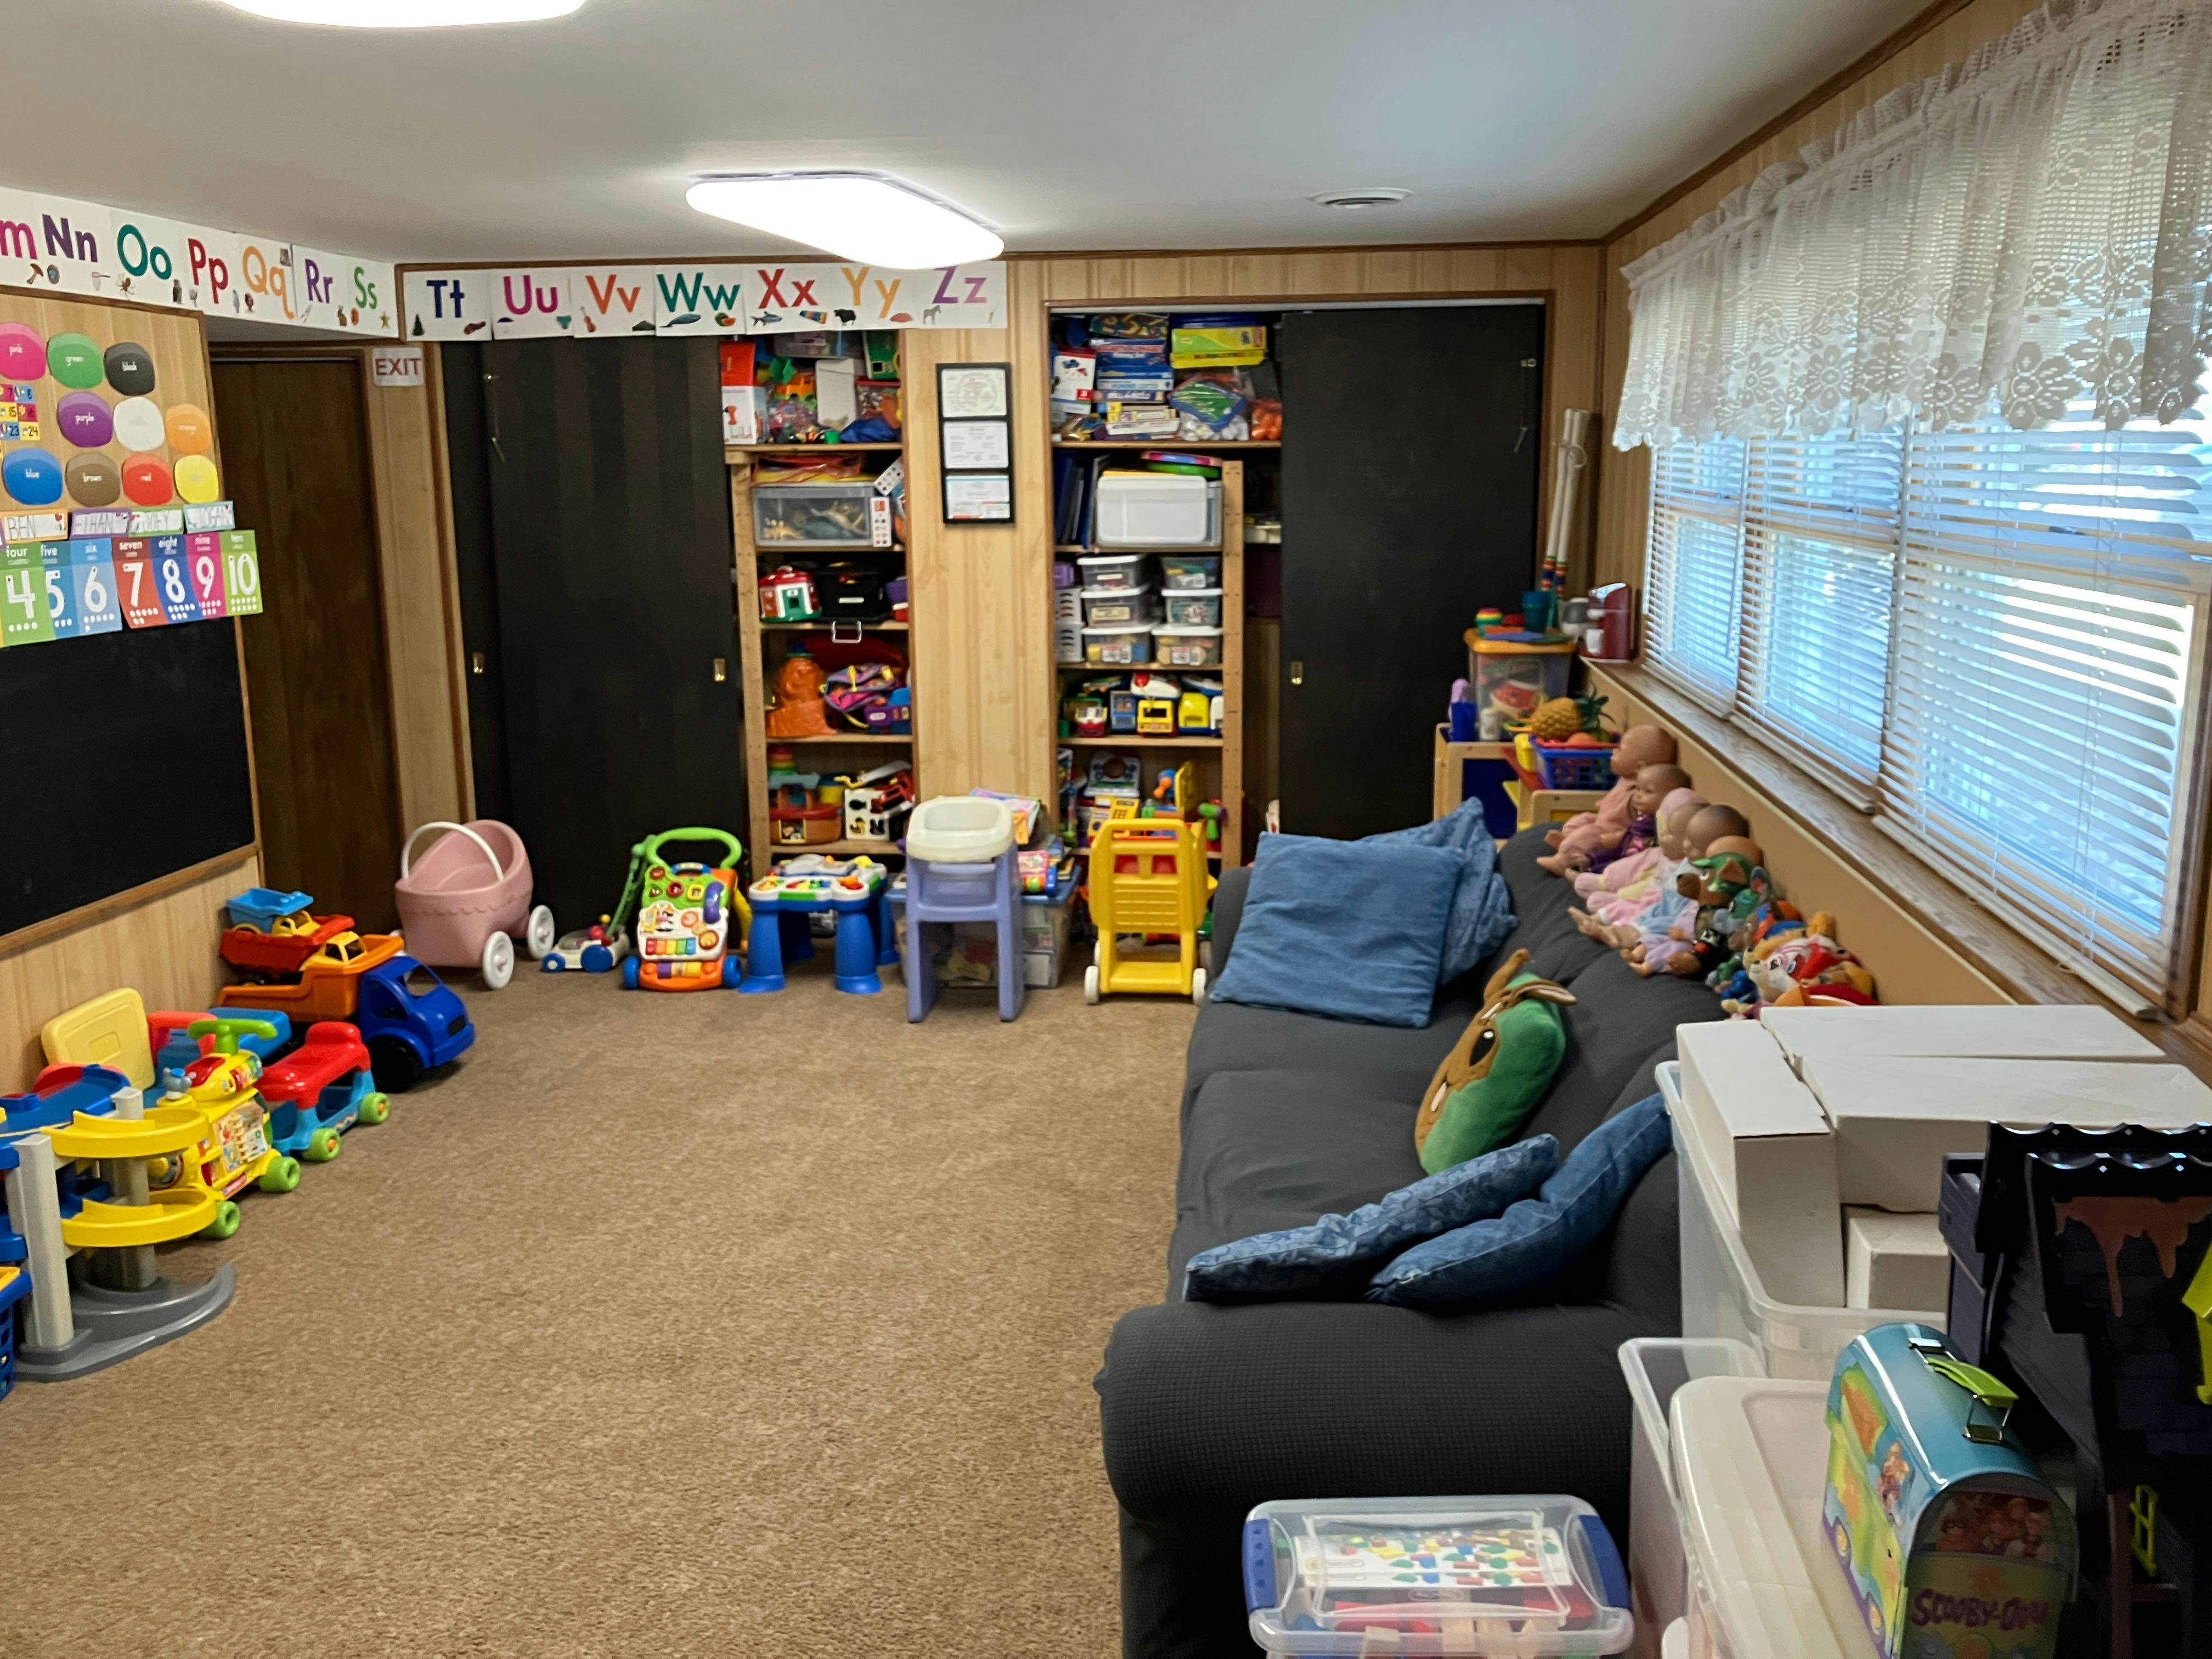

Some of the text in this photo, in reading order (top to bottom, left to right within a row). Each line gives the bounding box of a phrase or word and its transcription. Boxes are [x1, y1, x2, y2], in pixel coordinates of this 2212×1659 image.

[42, 213, 98, 263] Nn
[117, 224, 172, 280] Oo
[188, 238, 228, 304] Pp
[242, 245, 295, 320] Qq
[305, 258, 334, 304] Rr
[354, 266, 378, 310] Ss
[427, 266, 988, 319] Tt Uu Vv Ww Xx Yy Zz
[375, 358, 421, 376] EXIT
[9, 425, 38, 437] 23 24
[7, 515, 37, 541] BEN
[119, 541, 143, 551] seven
[6, 545, 27, 557] four
[5, 571, 36, 618] 4
[46, 570, 65, 618] 5
[85, 566, 107, 613] 6
[123, 562, 144, 607] 7
[162, 558, 185, 603] 8
[196, 556, 215, 599] 9
[228, 553, 257, 596] 10
